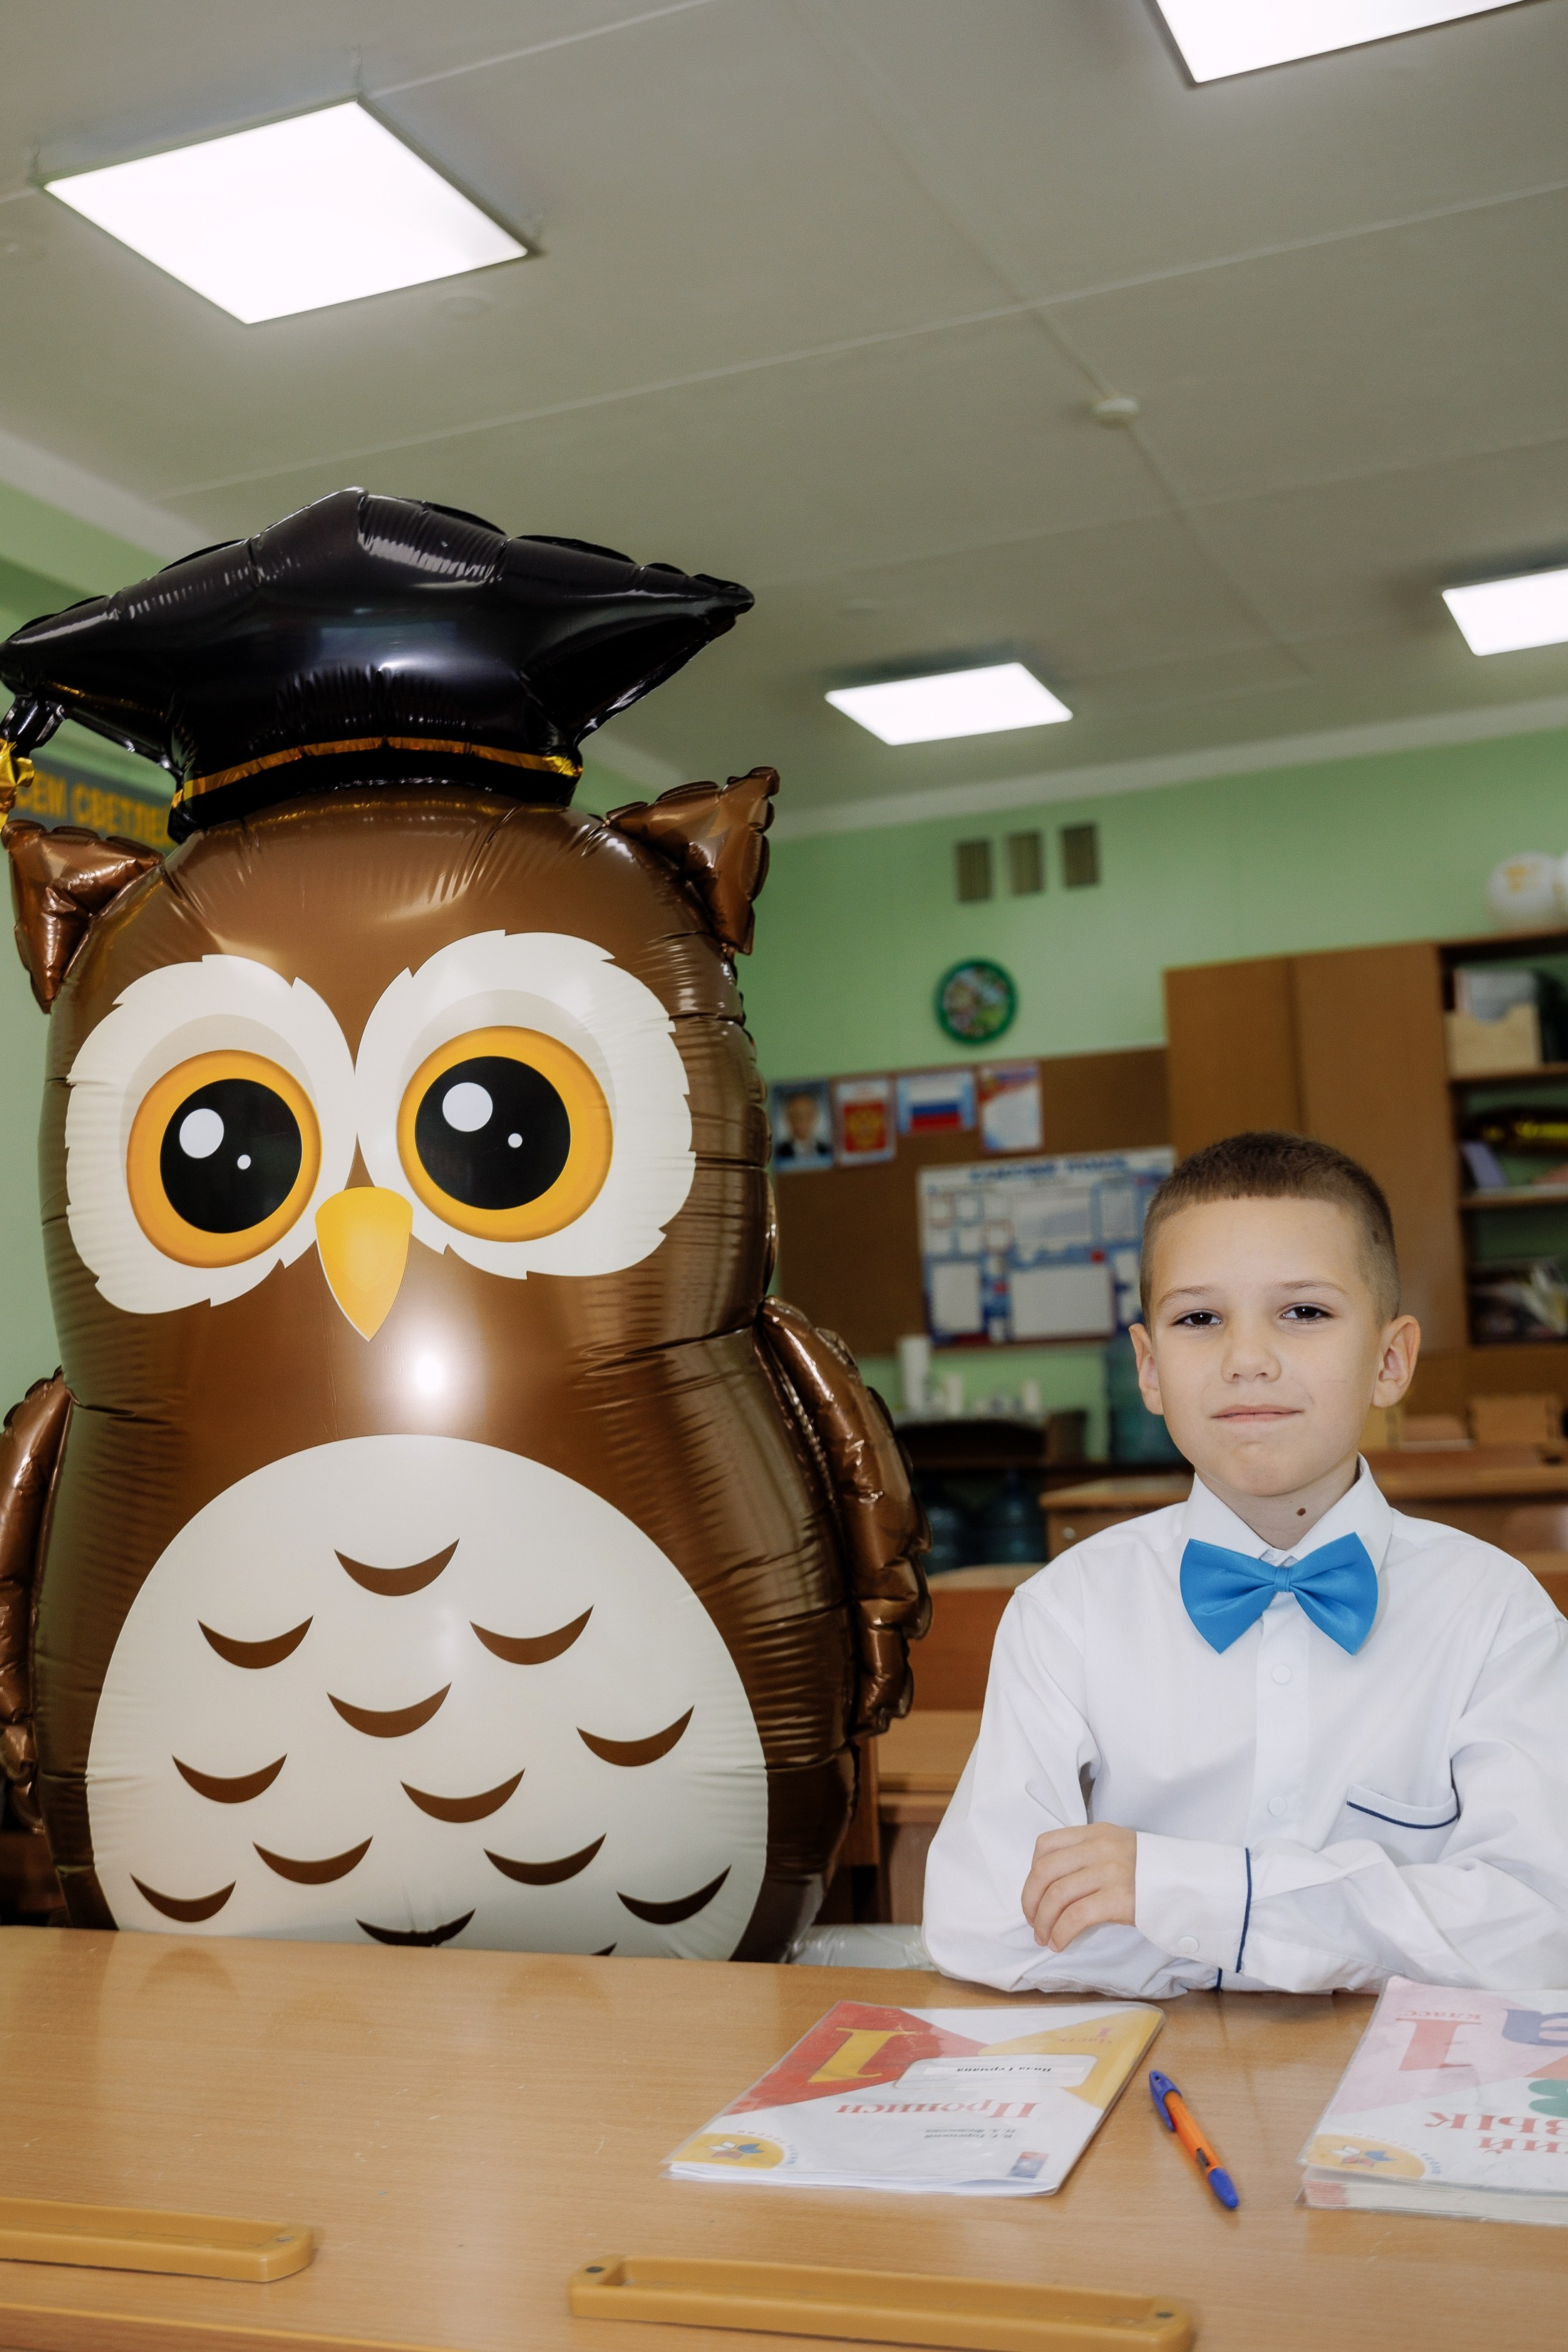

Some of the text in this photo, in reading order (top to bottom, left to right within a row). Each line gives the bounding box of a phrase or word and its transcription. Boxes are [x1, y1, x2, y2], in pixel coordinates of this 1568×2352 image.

[808, 2027, 917, 2083] 1
[1396, 2018, 1482, 2071] 1
[835, 2100, 1040, 2118] Прописи
